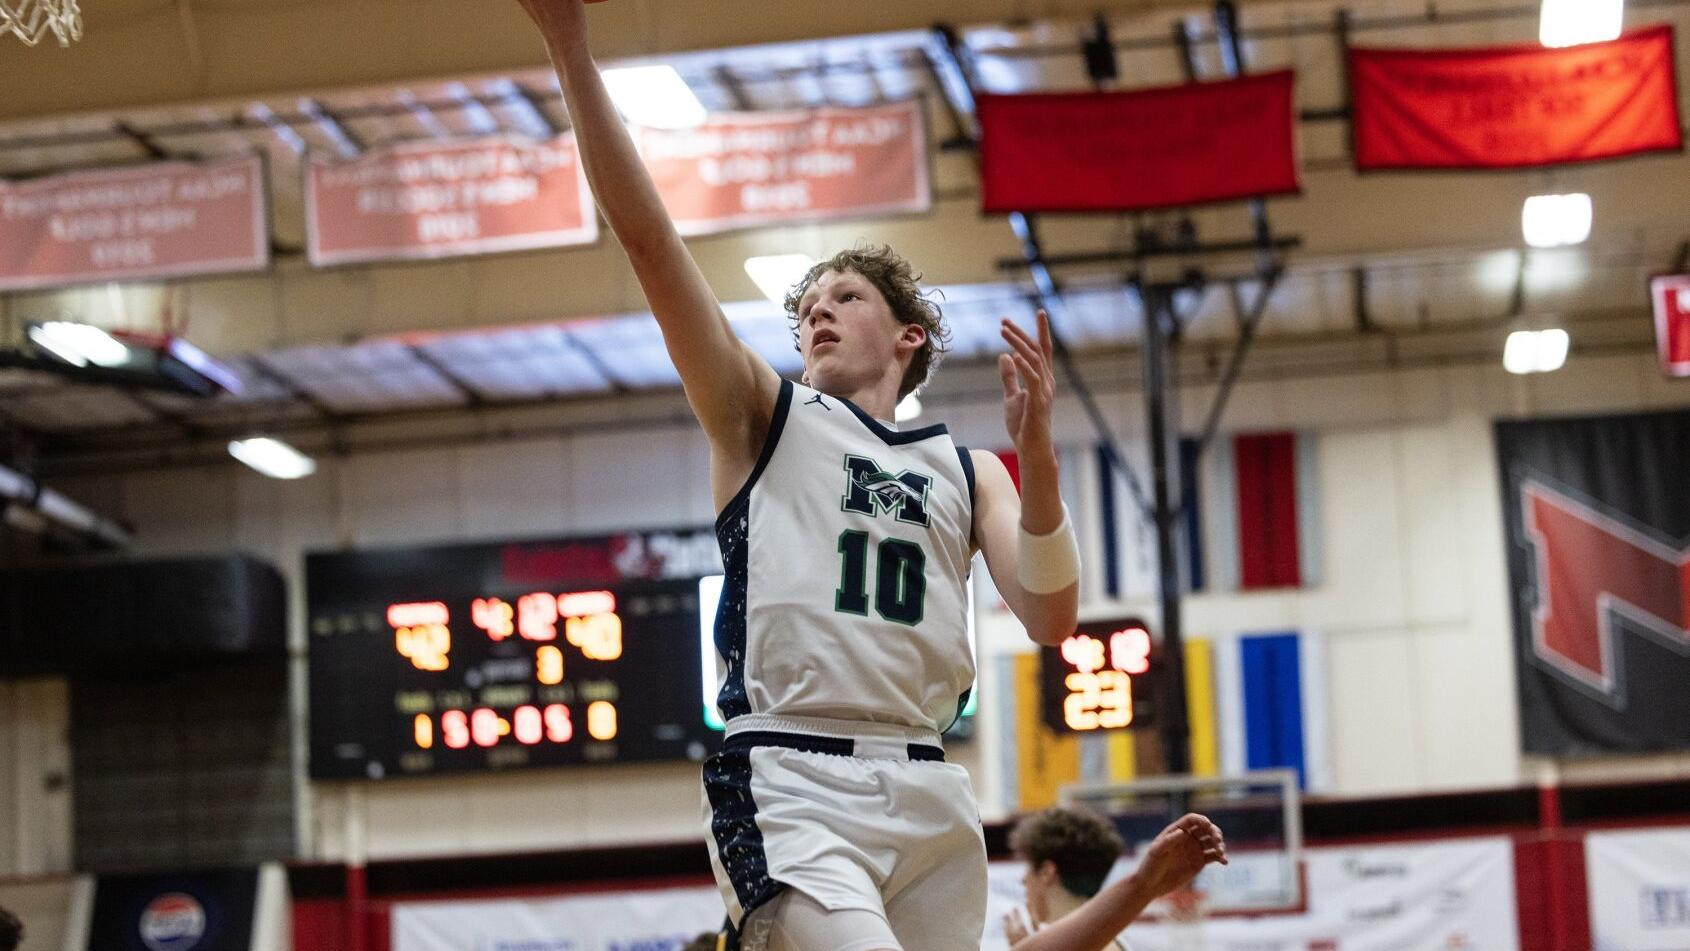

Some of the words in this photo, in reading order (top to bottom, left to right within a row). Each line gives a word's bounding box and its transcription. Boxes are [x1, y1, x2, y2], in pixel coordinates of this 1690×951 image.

[841, 453, 933, 528] M
[834, 528, 927, 627] 10
[395, 623, 451, 671] 42
[1063, 670, 1133, 731] 23
